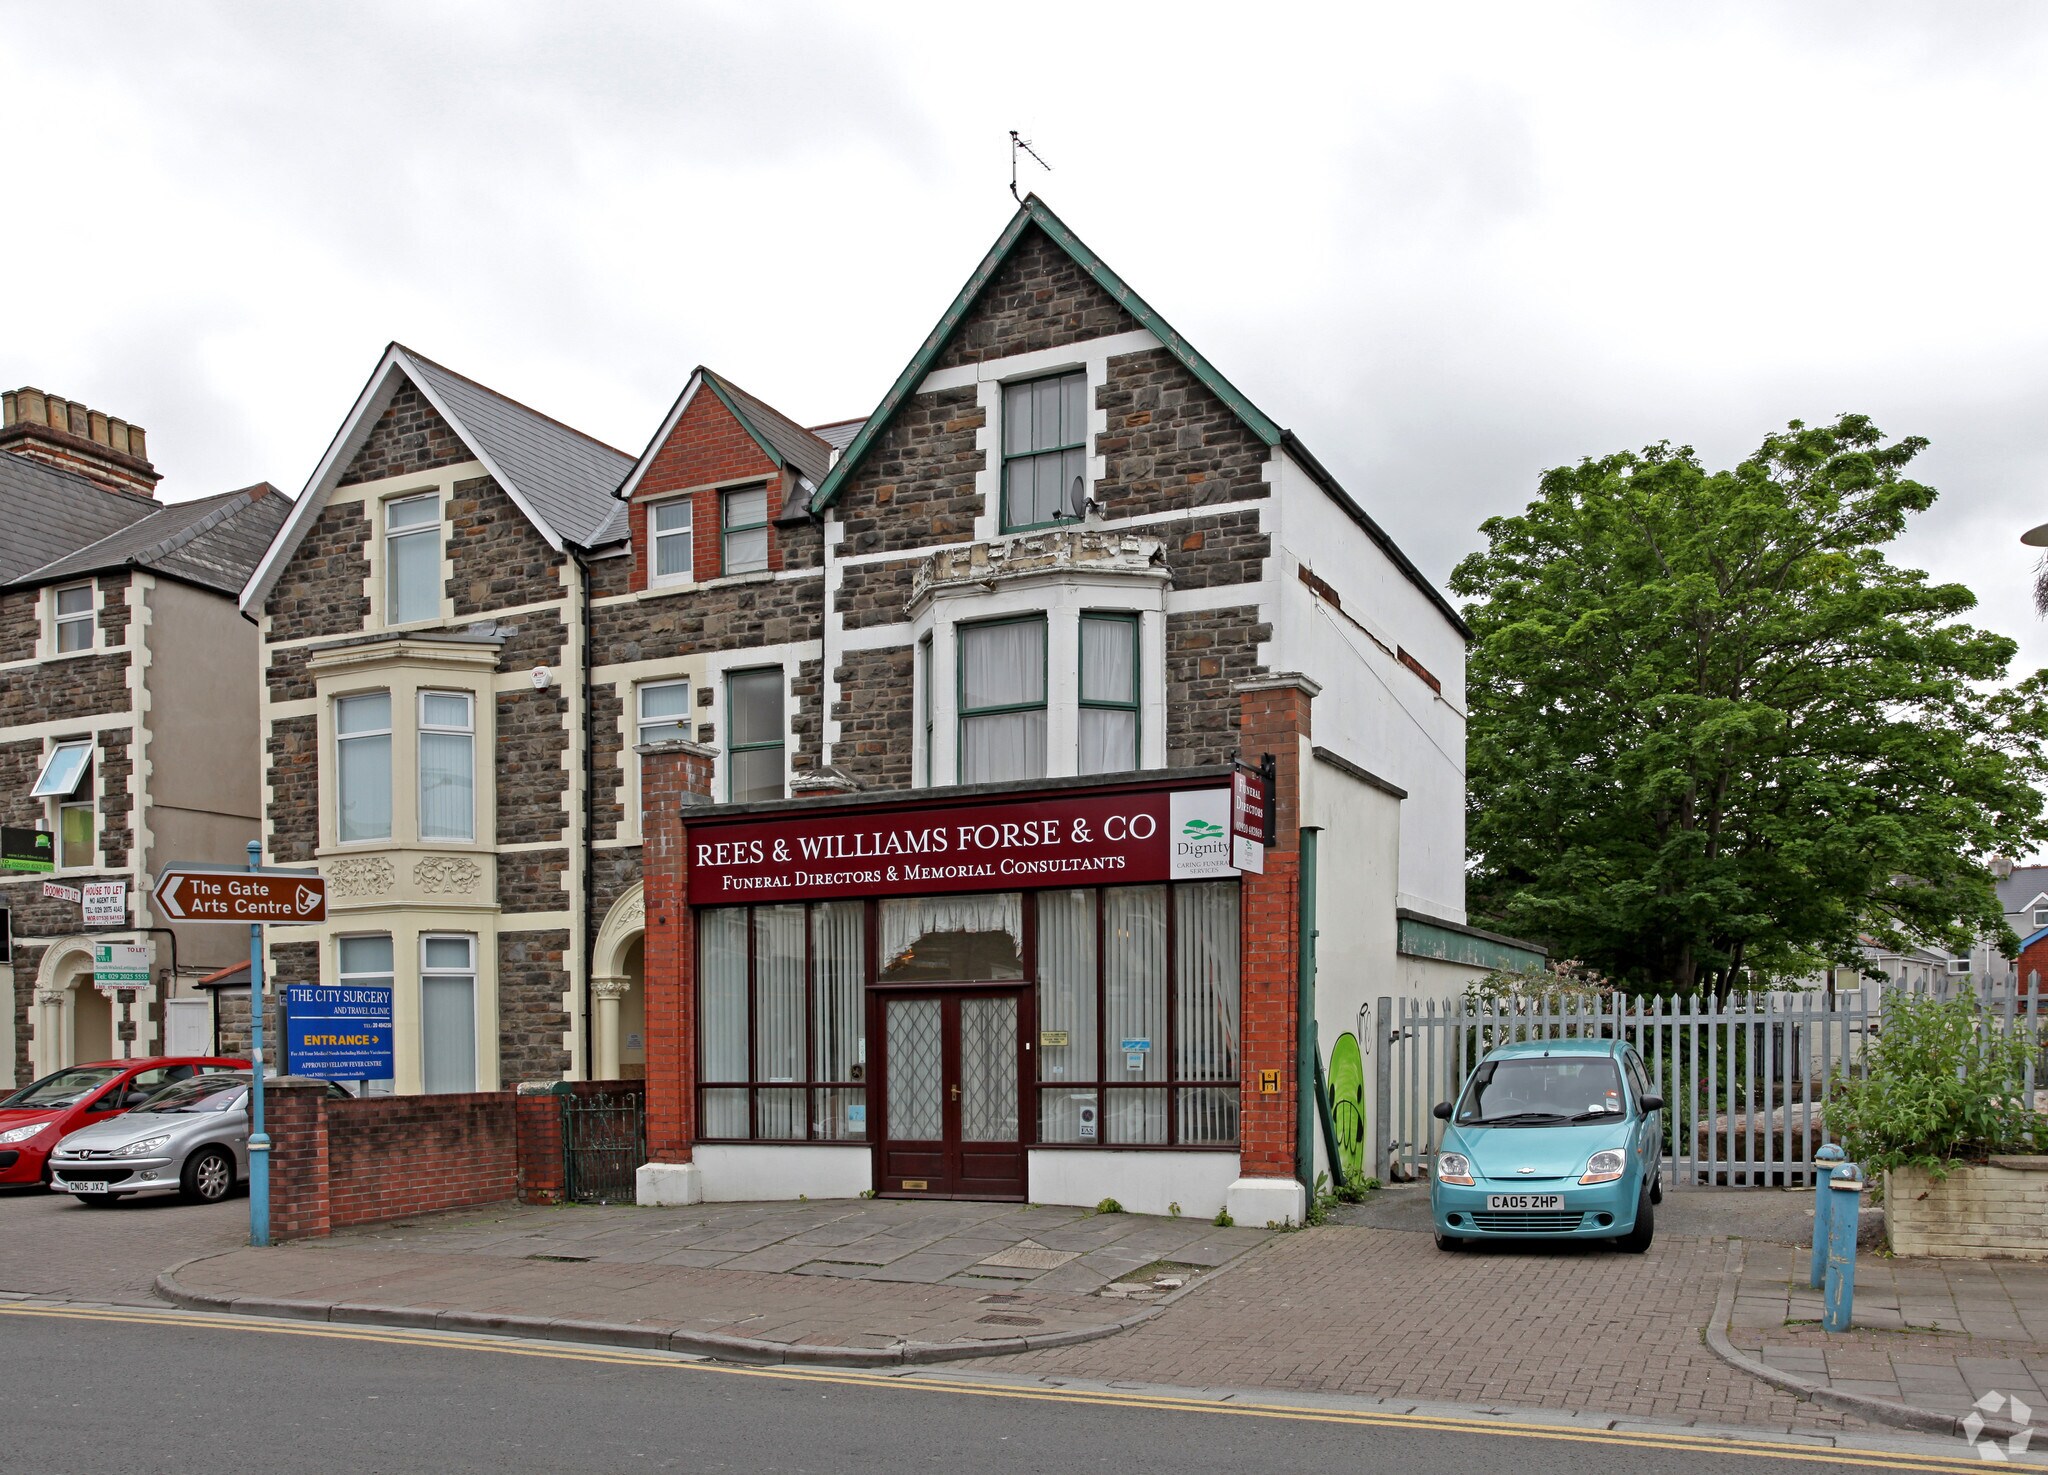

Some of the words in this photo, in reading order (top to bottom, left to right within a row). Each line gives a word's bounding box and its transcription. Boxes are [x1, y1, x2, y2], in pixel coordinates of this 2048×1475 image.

[1239, 778, 1261, 800] FUNERAL
[1236, 796, 1263, 818] DIRECTORS
[696, 840, 764, 867] REES
[772, 838, 792, 862] &
[797, 827, 948, 860] WILLIAMS
[957, 819, 1061, 851] FORSE
[1070, 817, 1094, 843] &
[1103, 813, 1157, 841] CO
[1177, 841, 1230, 858] Dignity
[1176, 861, 1201, 869] CARING
[1202, 860, 1230, 868] FUNERA
[1189, 867, 1219, 875] SERVICES
[722, 875, 791, 891] FUNERAL
[794, 869, 881, 887] DIRECTORS
[886, 865, 900, 881] &
[903, 863, 996, 881] MEMORIAL
[1000, 855, 1126, 875] CONSULTANTS
[45, 885, 64, 898] ROOMS
[65, 889, 70, 899] TO
[85, 886, 102, 896] HOUSE
[104, 886, 111, 895] TO
[113, 885, 123, 895] LET
[190, 880, 221, 895] The
[228, 881, 270, 896] Gate
[191, 899, 228, 913] Arts
[235, 899, 292, 914] Centre
[290, 989, 313, 1002] THE
[315, 989, 341, 1003] CITY
[343, 990, 389, 1004] SURGERY
[333, 1006, 347, 1014] AND
[370, 1007, 390, 1015] CLINIC
[304, 1034, 370, 1046] ENTRANCE
[1262, 1071, 1278, 1092] H
[70, 1182, 88, 1191] CN05
[91, 1182, 104, 1191] JXZ
[1492, 1196, 1528, 1208] CA05
[1531, 1196, 1558, 1208] ZHP
